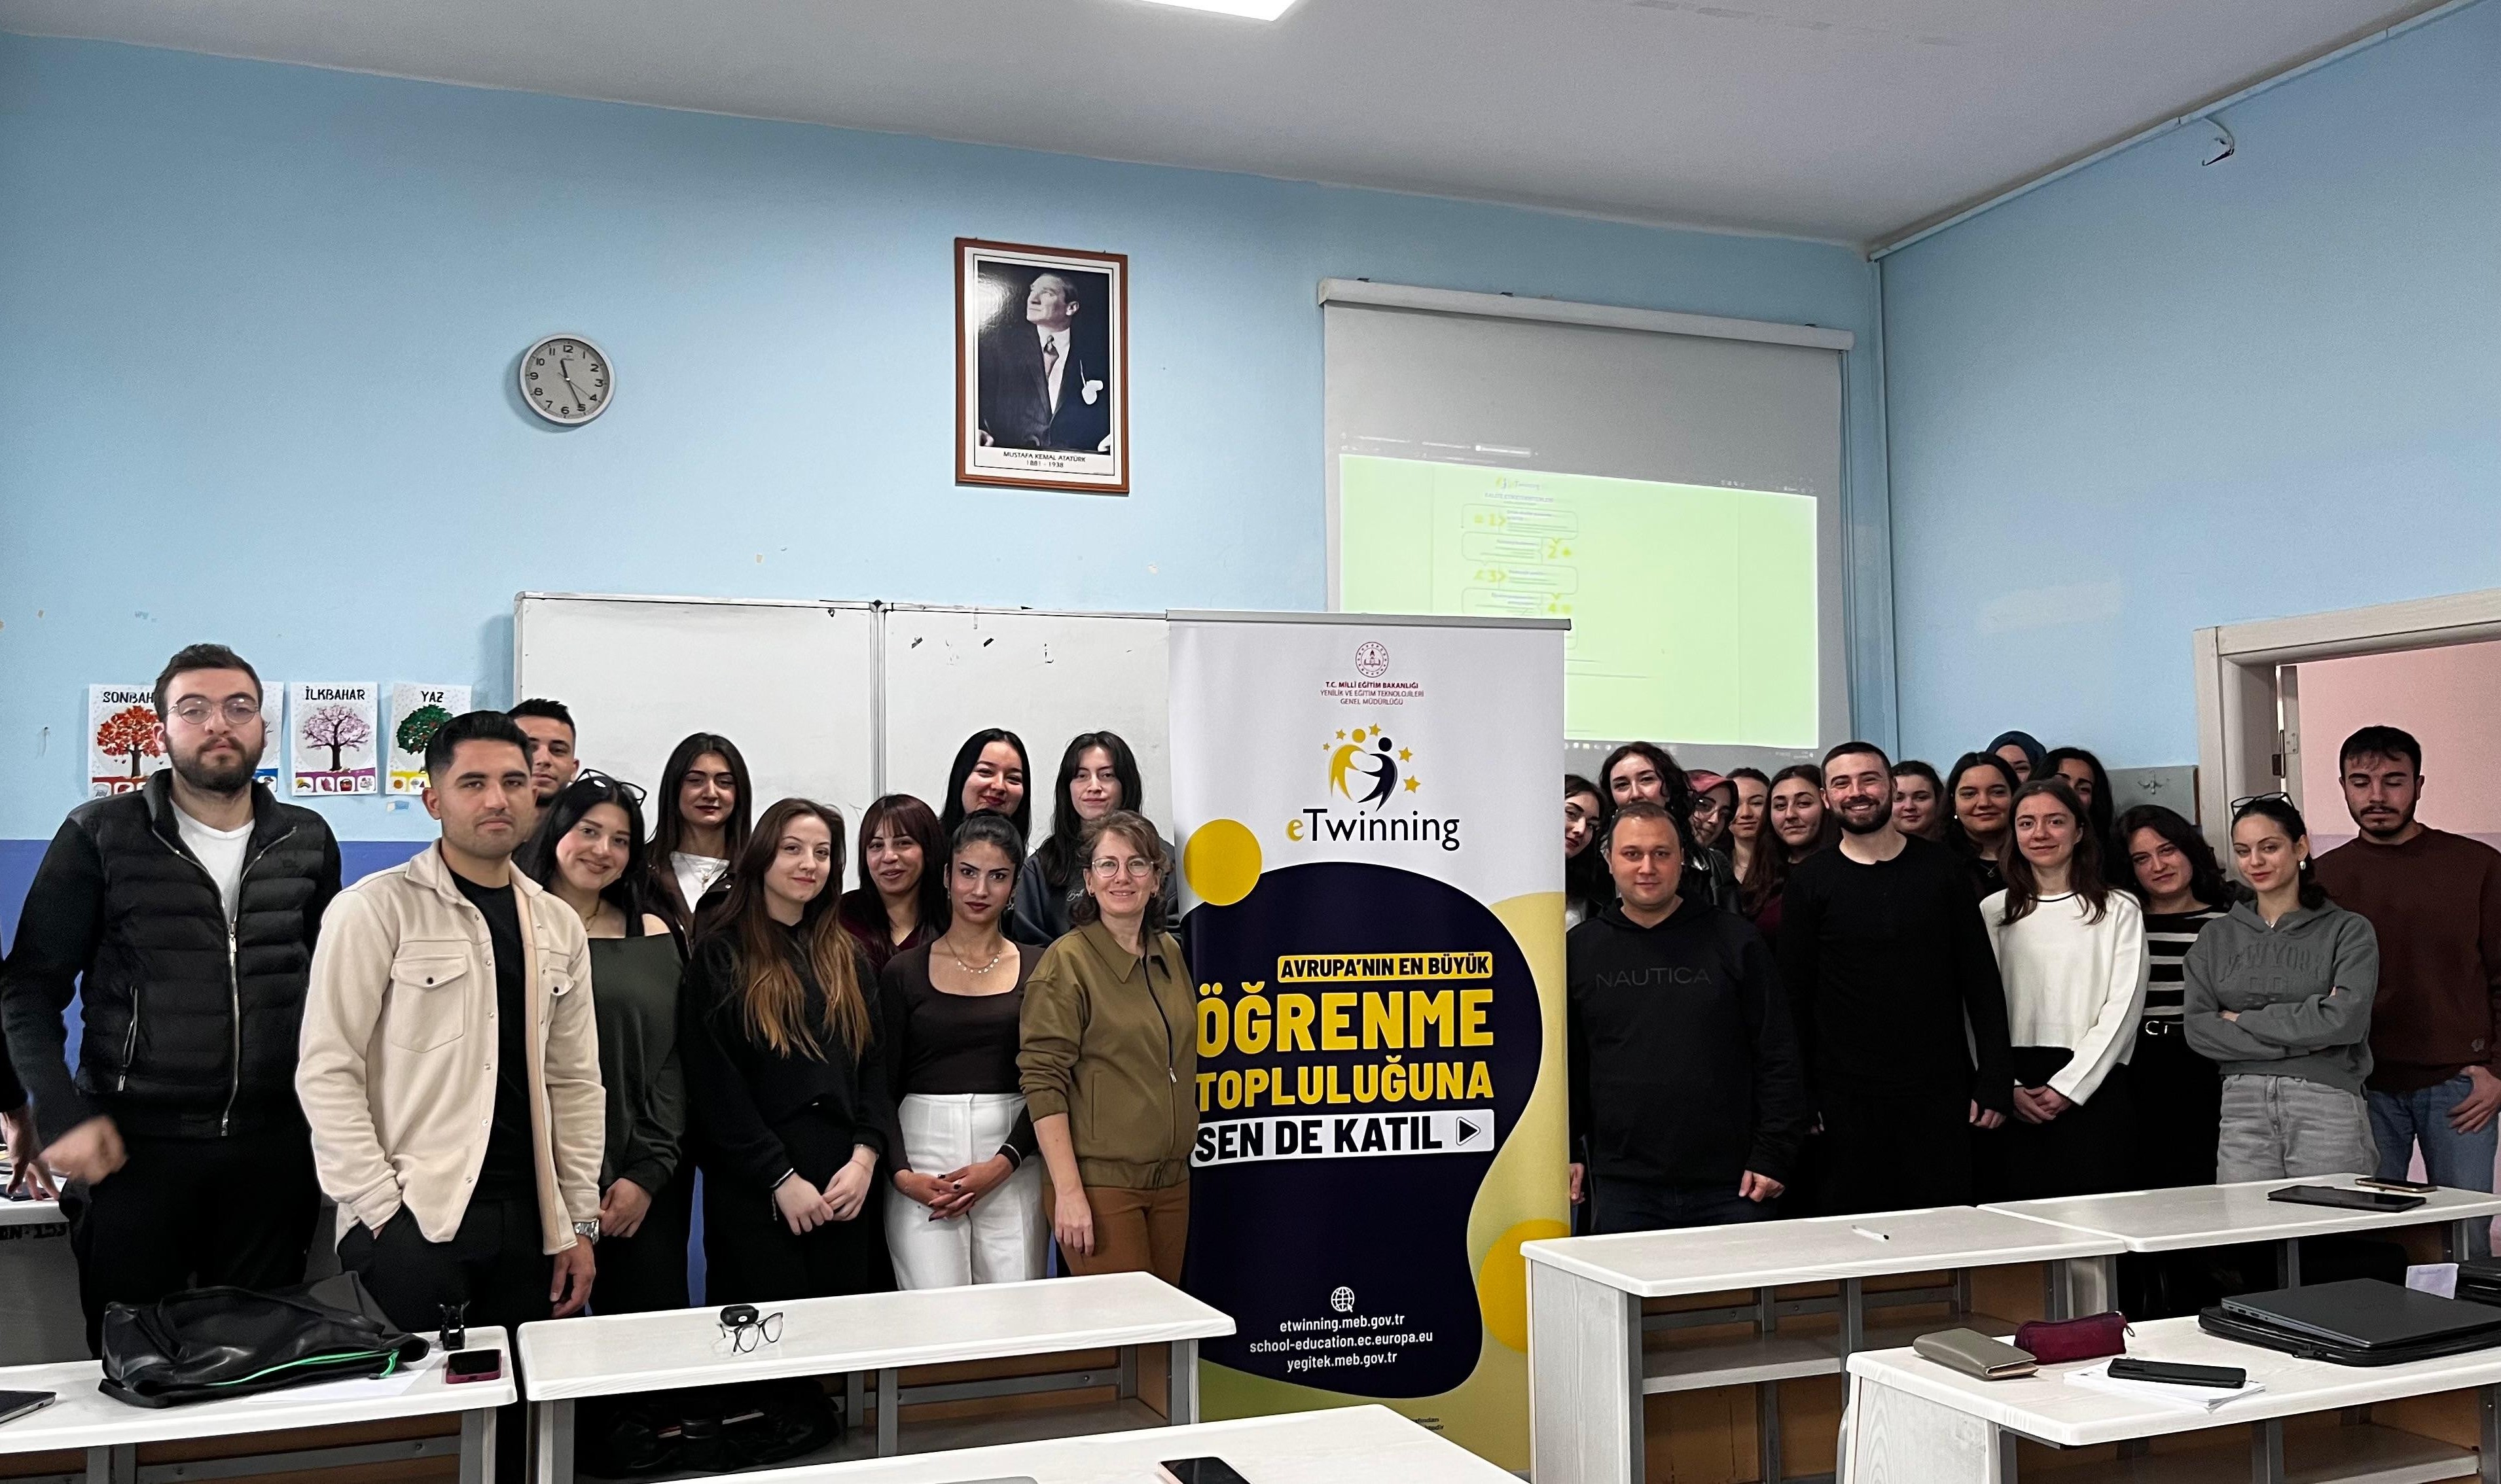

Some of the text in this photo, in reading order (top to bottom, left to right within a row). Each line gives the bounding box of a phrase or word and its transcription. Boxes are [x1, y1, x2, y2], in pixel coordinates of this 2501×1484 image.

[563, 345, 573, 353] 12
[536, 358, 545, 366] 10
[590, 364, 600, 372] 2
[594, 379, 603, 387] 3
[534, 387, 543, 396] 8
[545, 400, 553, 409] 7
[561, 406, 569, 415] 6
[103, 691, 154, 703] SONBAH
[305, 686, 365, 700] İLKBAHAR
[421, 691, 444, 702] YAZ
[1286, 808, 1460, 851] eTwinning
[1281, 953, 1490, 978] AVRUPA'NIN EN BÜYÜK
[1596, 967, 1712, 990] NAUTICA
[1196, 981, 1494, 1058] ÖĞRENME
[1196, 1055, 1494, 1112] TOPLULUĞUNA
[1195, 1116, 1443, 1163] SEN DE KATIL
[1280, 1313, 1405, 1334] etwinning.meb.gov.tr
[1250, 1331, 1433, 1353] school-education.ec.europa.eu
[1287, 1351, 1397, 1373] yegitek.meb.gov.tr
